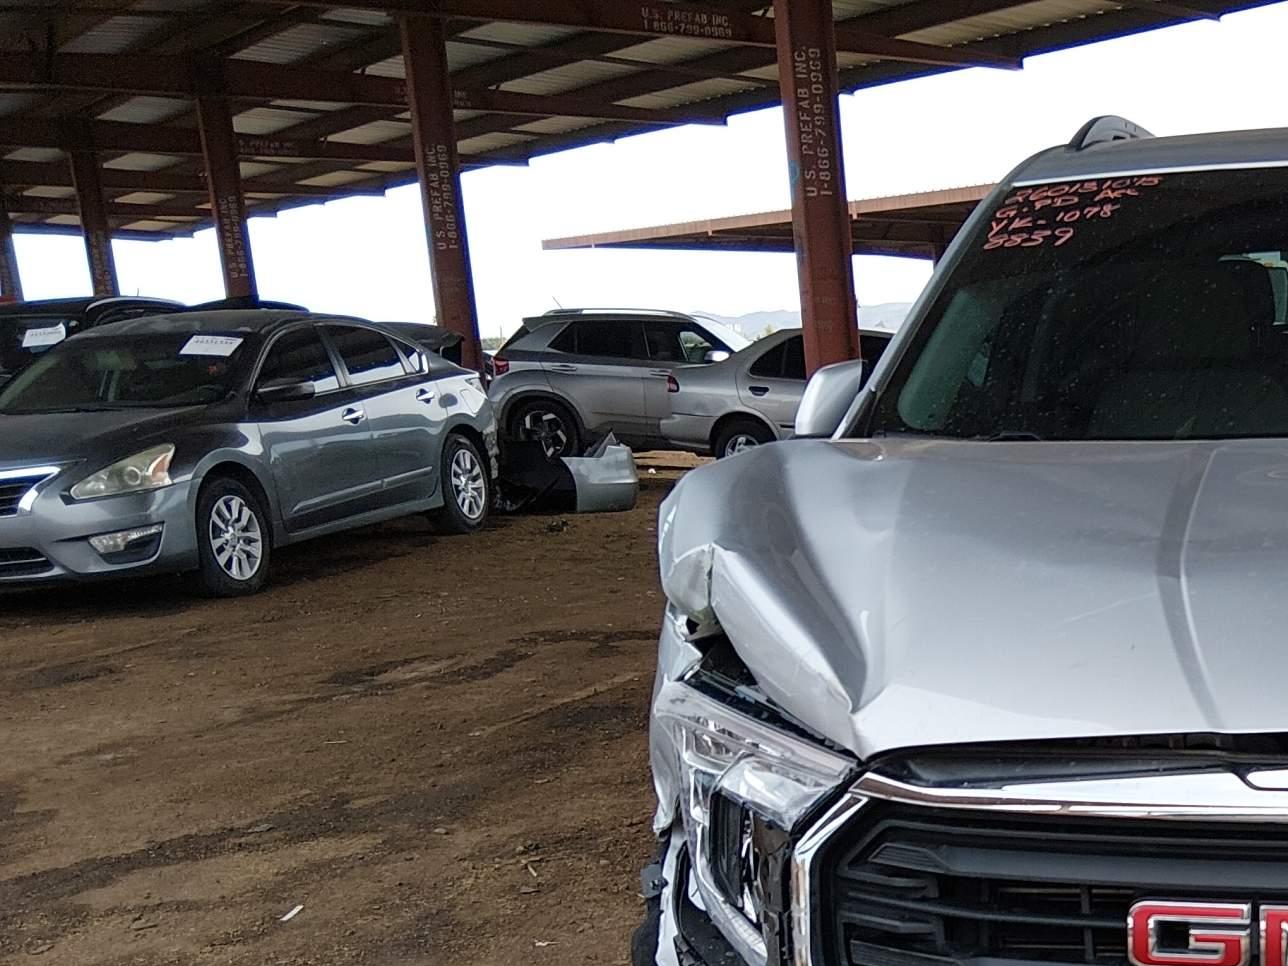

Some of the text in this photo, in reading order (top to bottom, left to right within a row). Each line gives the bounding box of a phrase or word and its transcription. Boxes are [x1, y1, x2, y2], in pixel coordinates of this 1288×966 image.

[794, 45, 818, 197] U.S. PREFAB INC.
